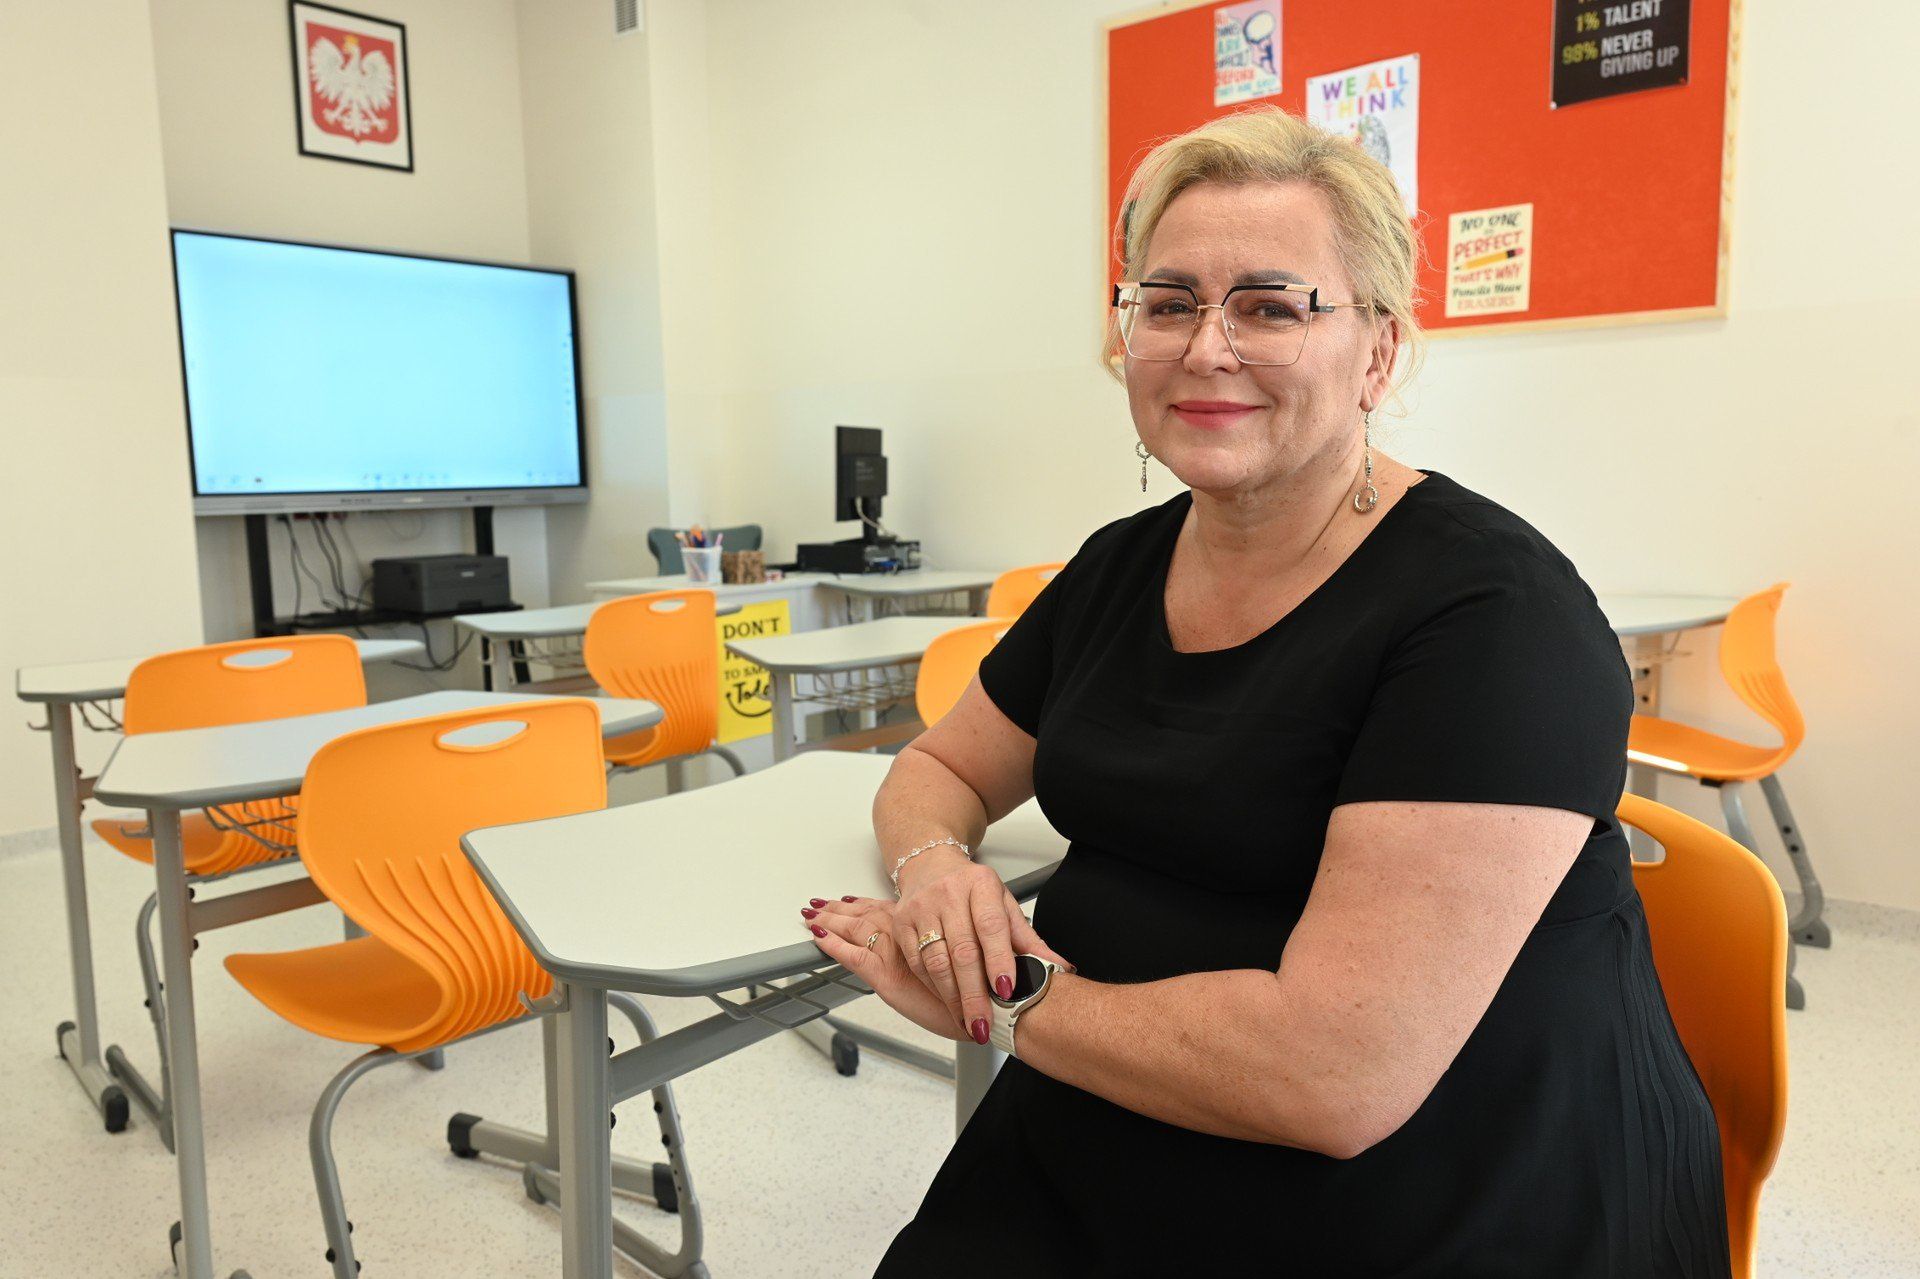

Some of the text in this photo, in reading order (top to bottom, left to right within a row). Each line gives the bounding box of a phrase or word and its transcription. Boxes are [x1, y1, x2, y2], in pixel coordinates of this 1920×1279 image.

[1575, 0, 1660, 33] 1% TALENT
[1601, 29, 1653, 57] NEVER
[1601, 45, 1680, 78] GIVING UP
[1322, 66, 1408, 101] WE ALL
[1323, 88, 1405, 120] THINK
[1460, 217, 1484, 232] NO
[1454, 229, 1524, 259] PERFECT
[1495, 261, 1523, 280] WHY
[723, 617, 780, 639] DON'T
